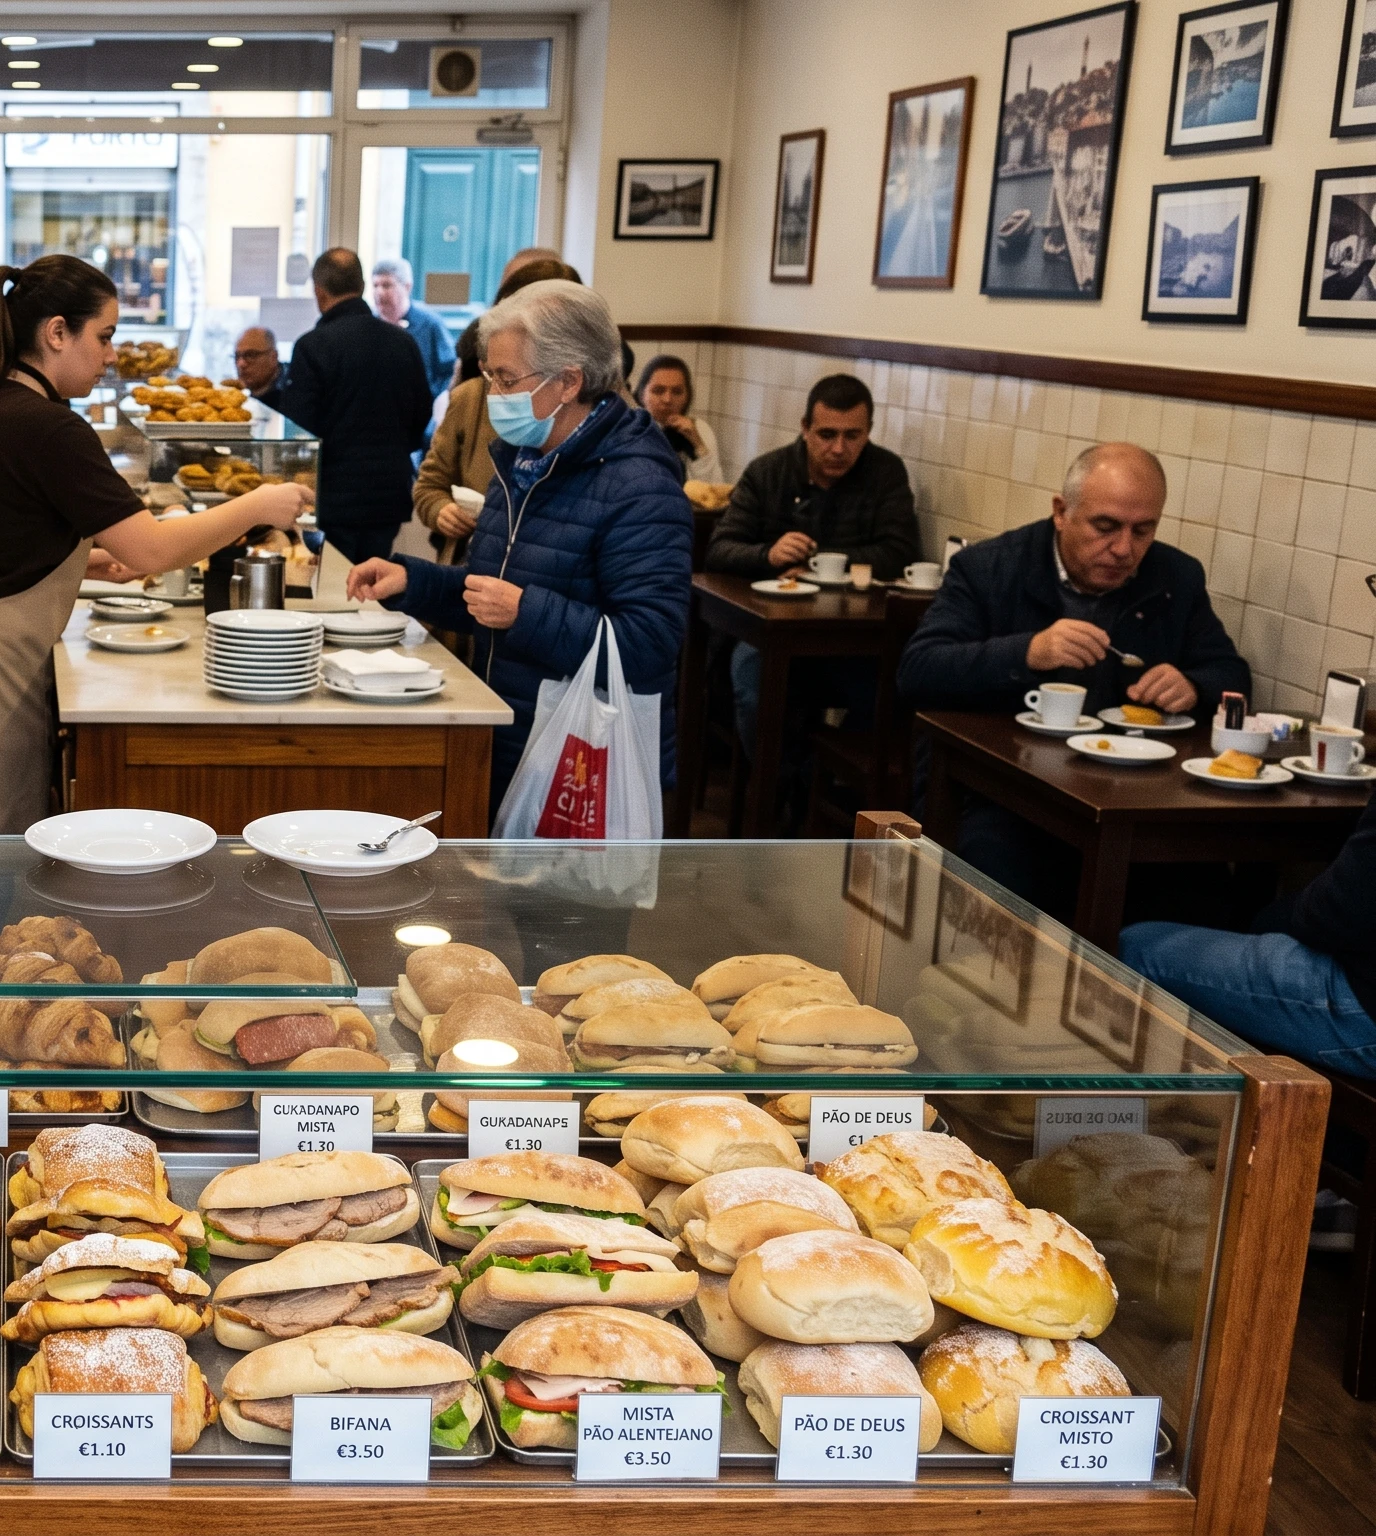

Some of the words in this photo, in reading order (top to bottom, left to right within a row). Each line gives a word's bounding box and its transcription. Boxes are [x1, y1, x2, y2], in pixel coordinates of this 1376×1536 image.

[822, 1109, 850, 1124] PÃO
[854, 1111, 872, 1124] DE
[876, 1112, 912, 1124] DEUS
[297, 1121, 336, 1133] MISTA
[297, 1140, 335, 1152] €1.30
[505, 1138, 542, 1151] €1.30
[623, 1406, 675, 1421] MISTA
[1040, 1410, 1135, 1425] CROISSANT
[51, 1414, 154, 1430] CROISSANTS
[330, 1416, 392, 1431] BIFANA
[794, 1414, 828, 1432] PÃO
[833, 1417, 856, 1432] DE
[860, 1418, 905, 1433] DEUS
[583, 1424, 614, 1441] PÃO
[617, 1427, 713, 1442] ALENTEJANO
[1059, 1431, 1114, 1445] MISTO
[78, 1442, 126, 1457] €1.10
[336, 1444, 384, 1459] €3.50
[825, 1445, 873, 1460] €1.30
[623, 1451, 671, 1466] €3.50
[1060, 1454, 1108, 1469] €1.30
